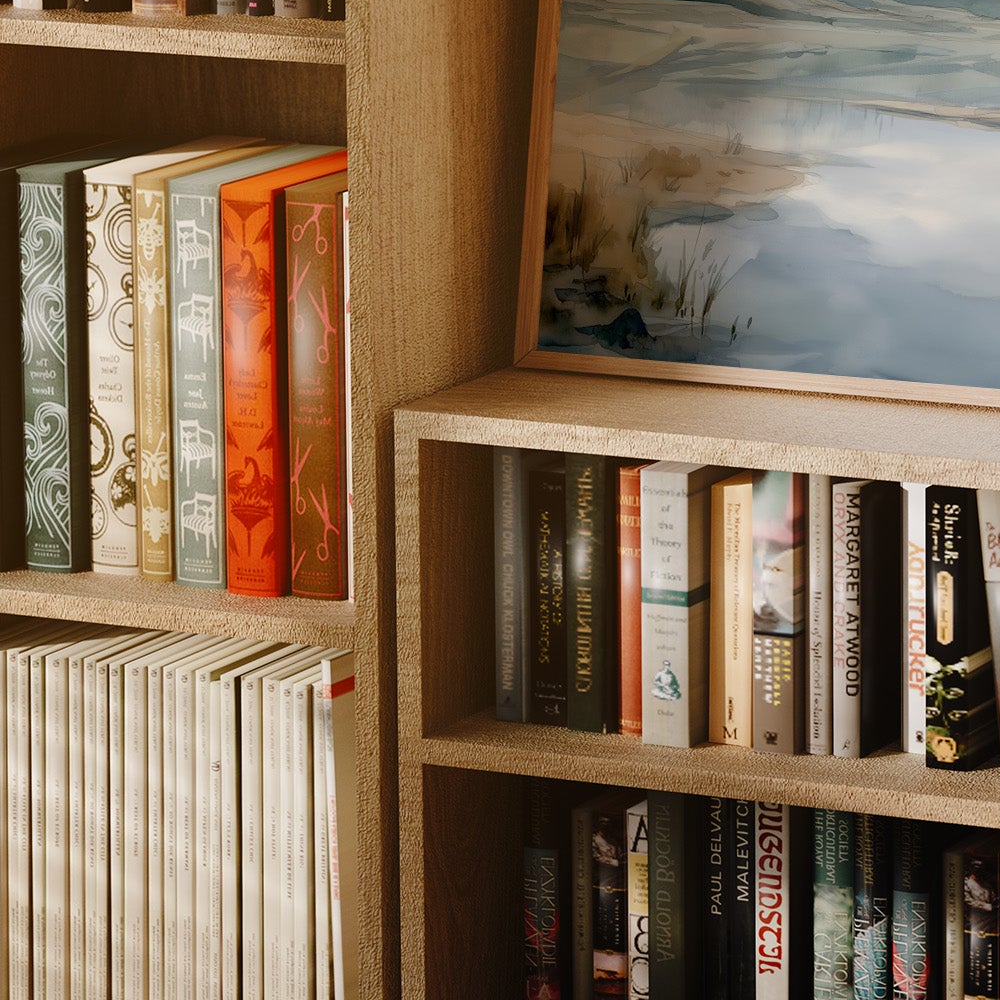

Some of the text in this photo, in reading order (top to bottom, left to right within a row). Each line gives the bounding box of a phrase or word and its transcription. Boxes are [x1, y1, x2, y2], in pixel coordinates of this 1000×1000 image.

[661, 504, 672, 514] of
[651, 537, 682, 549] Theory
[501, 455, 514, 691] DOWNTOWN OWL CHUCK KLOSTERMAN
[553, 563, 561, 610] HISTORY
[649, 571, 682, 582] Fiction
[833, 492, 845, 669] ORYX AND CRAKE
[813, 591, 822, 625] House
[845, 493, 860, 697] MARGARET ATWOOD
[723, 726, 738, 740] M
[710, 797, 723, 916] PAUL DELVAU
